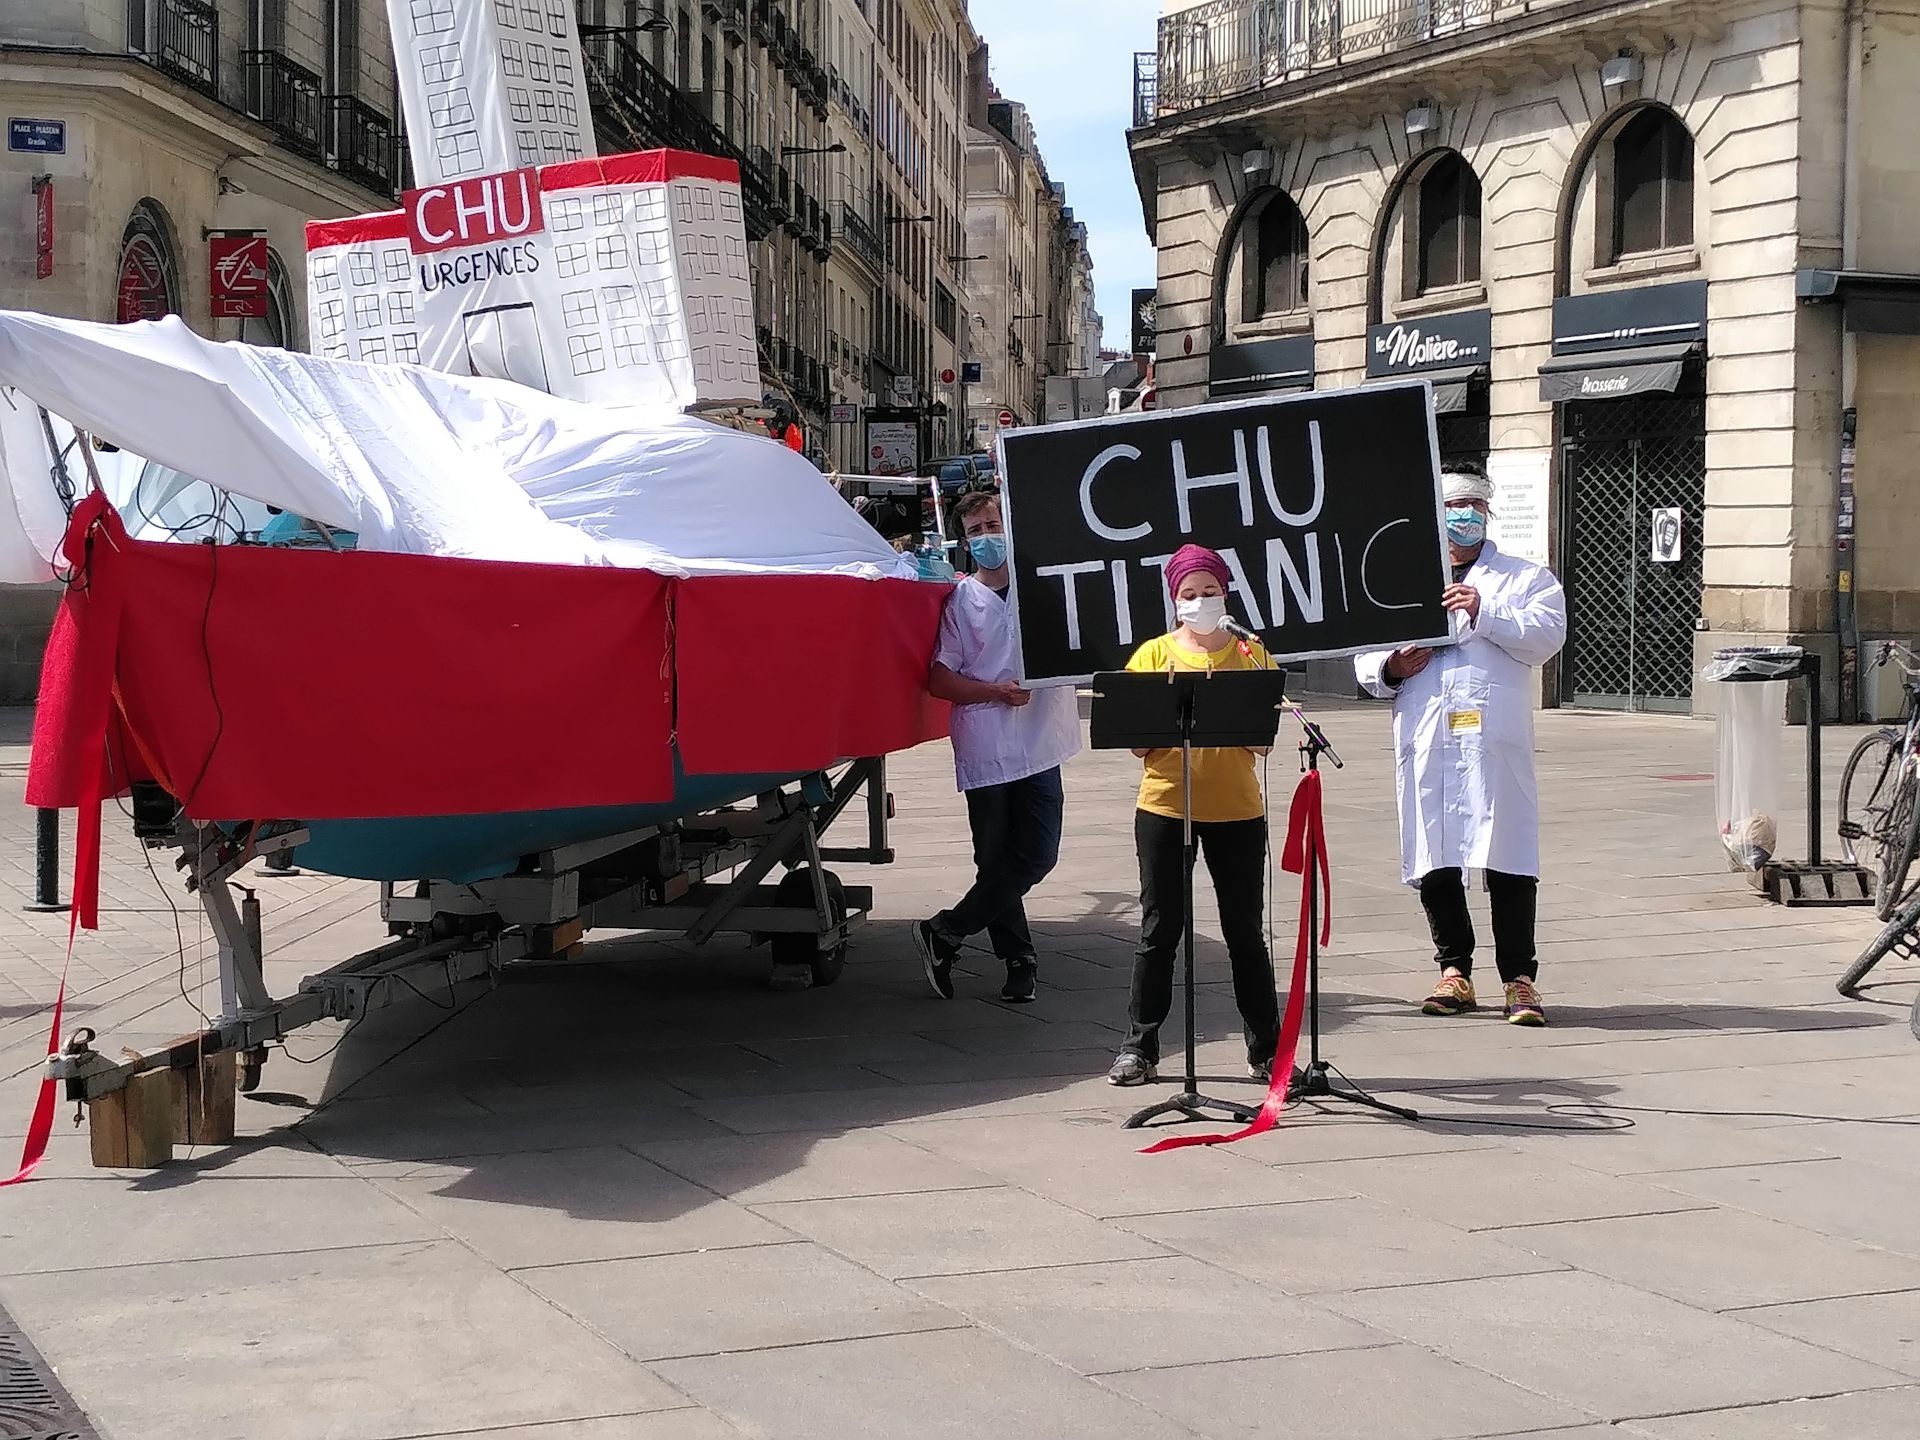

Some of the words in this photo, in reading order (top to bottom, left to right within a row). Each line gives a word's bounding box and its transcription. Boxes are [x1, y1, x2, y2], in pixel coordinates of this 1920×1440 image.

[416, 173, 531, 244] CHU
[421, 241, 539, 291] URGENCES
[1581, 375, 1629, 393] Brasserie
[1079, 420, 1325, 541] CHU
